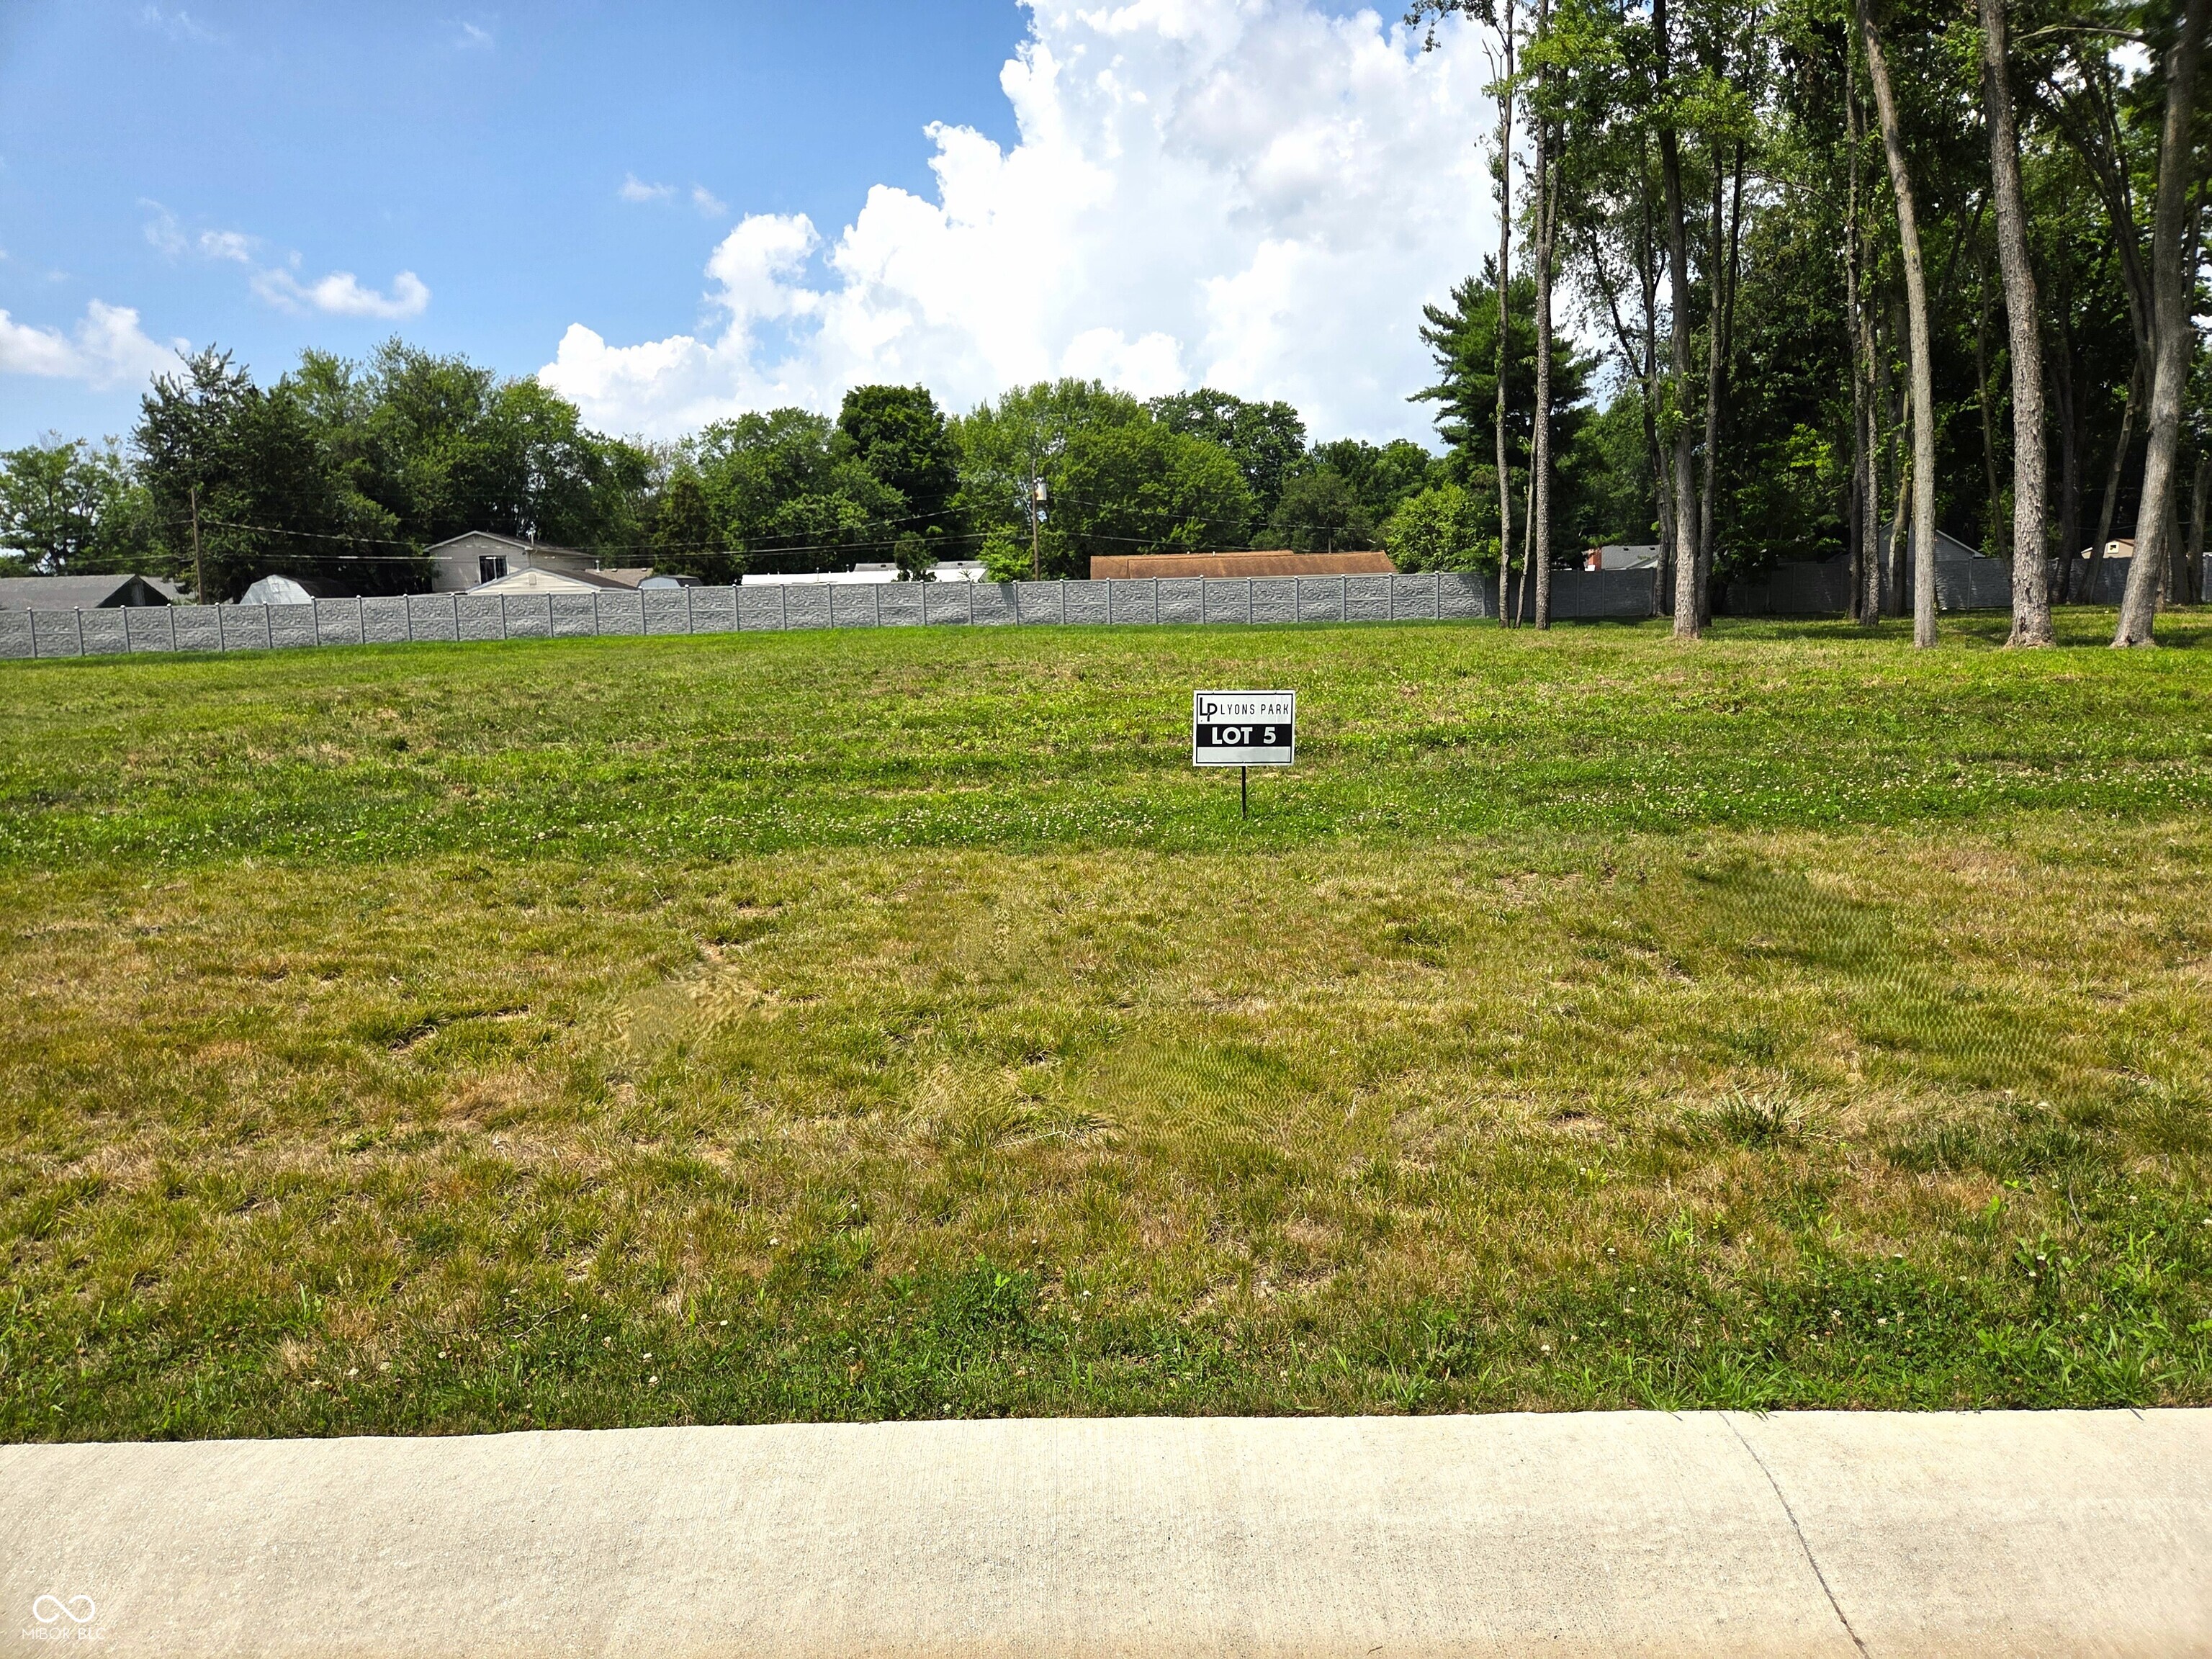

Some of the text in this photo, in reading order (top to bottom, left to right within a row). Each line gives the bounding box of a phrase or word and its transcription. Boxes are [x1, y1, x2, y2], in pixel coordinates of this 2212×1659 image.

[1220, 703, 1289, 715] LYONS PARK
[1212, 727, 1276, 745] LOT 5
